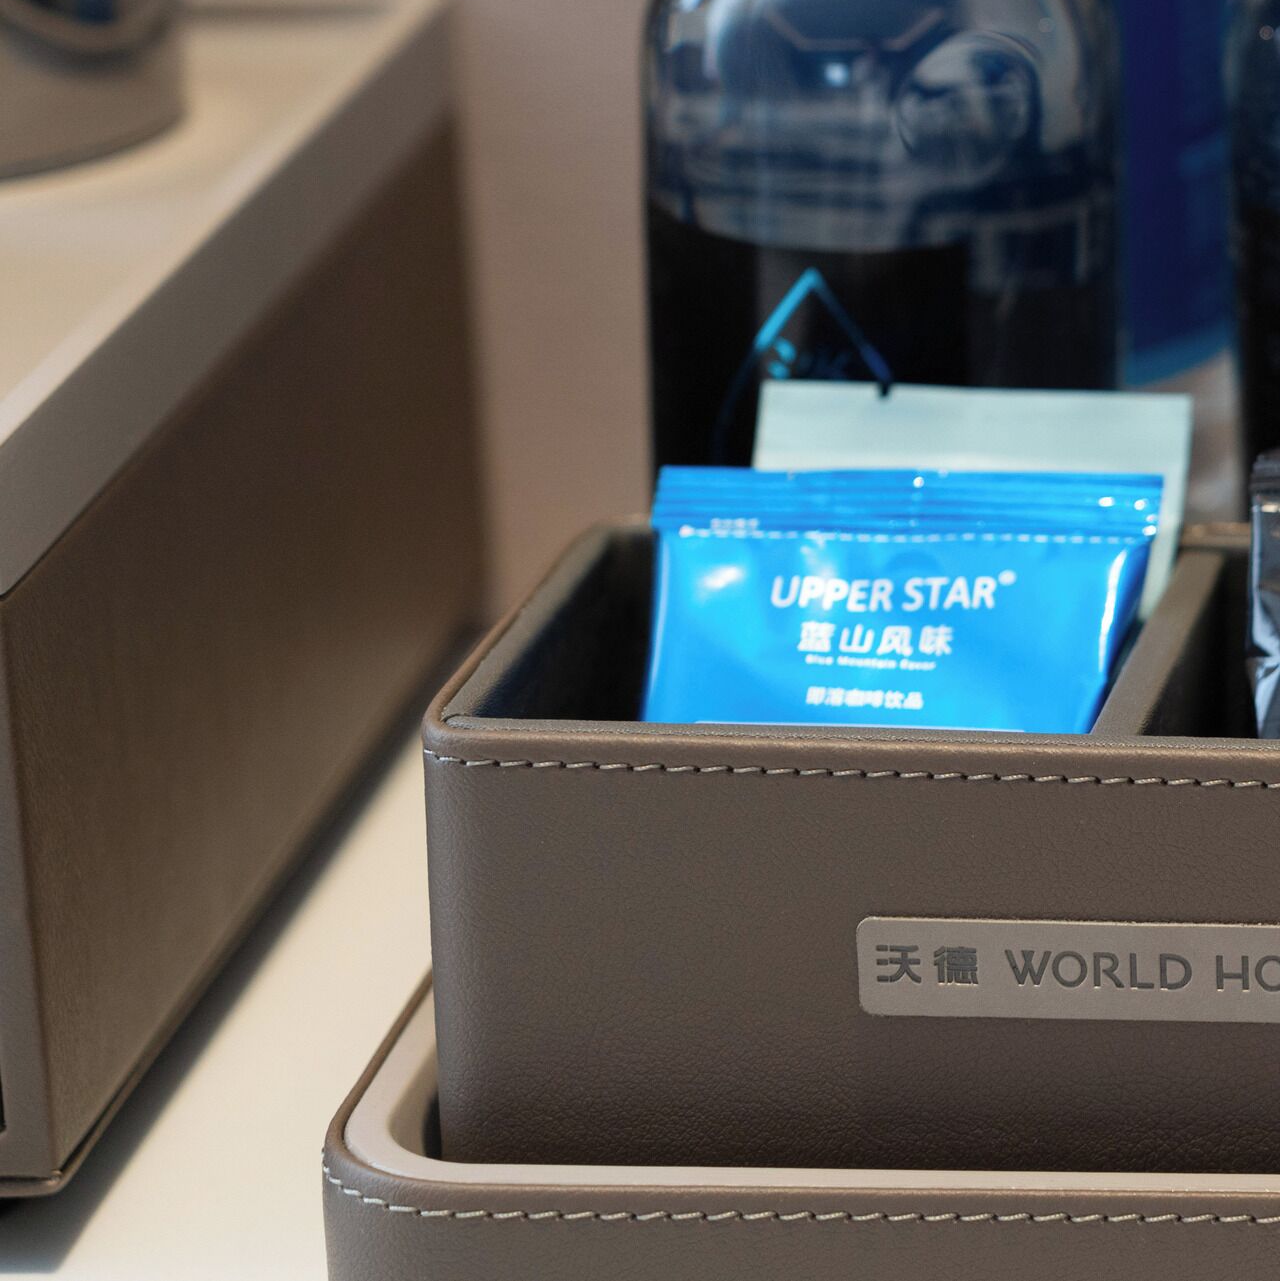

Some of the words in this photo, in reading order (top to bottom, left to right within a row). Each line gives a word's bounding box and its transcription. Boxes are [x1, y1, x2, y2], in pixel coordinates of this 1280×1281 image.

[770, 575, 894, 612] UPPER
[902, 576, 998, 612] STAR
[797, 620, 954, 657] 蓝山风味
[875, 944, 980, 986] 沃德
[1004, 948, 1194, 992] WORLD
